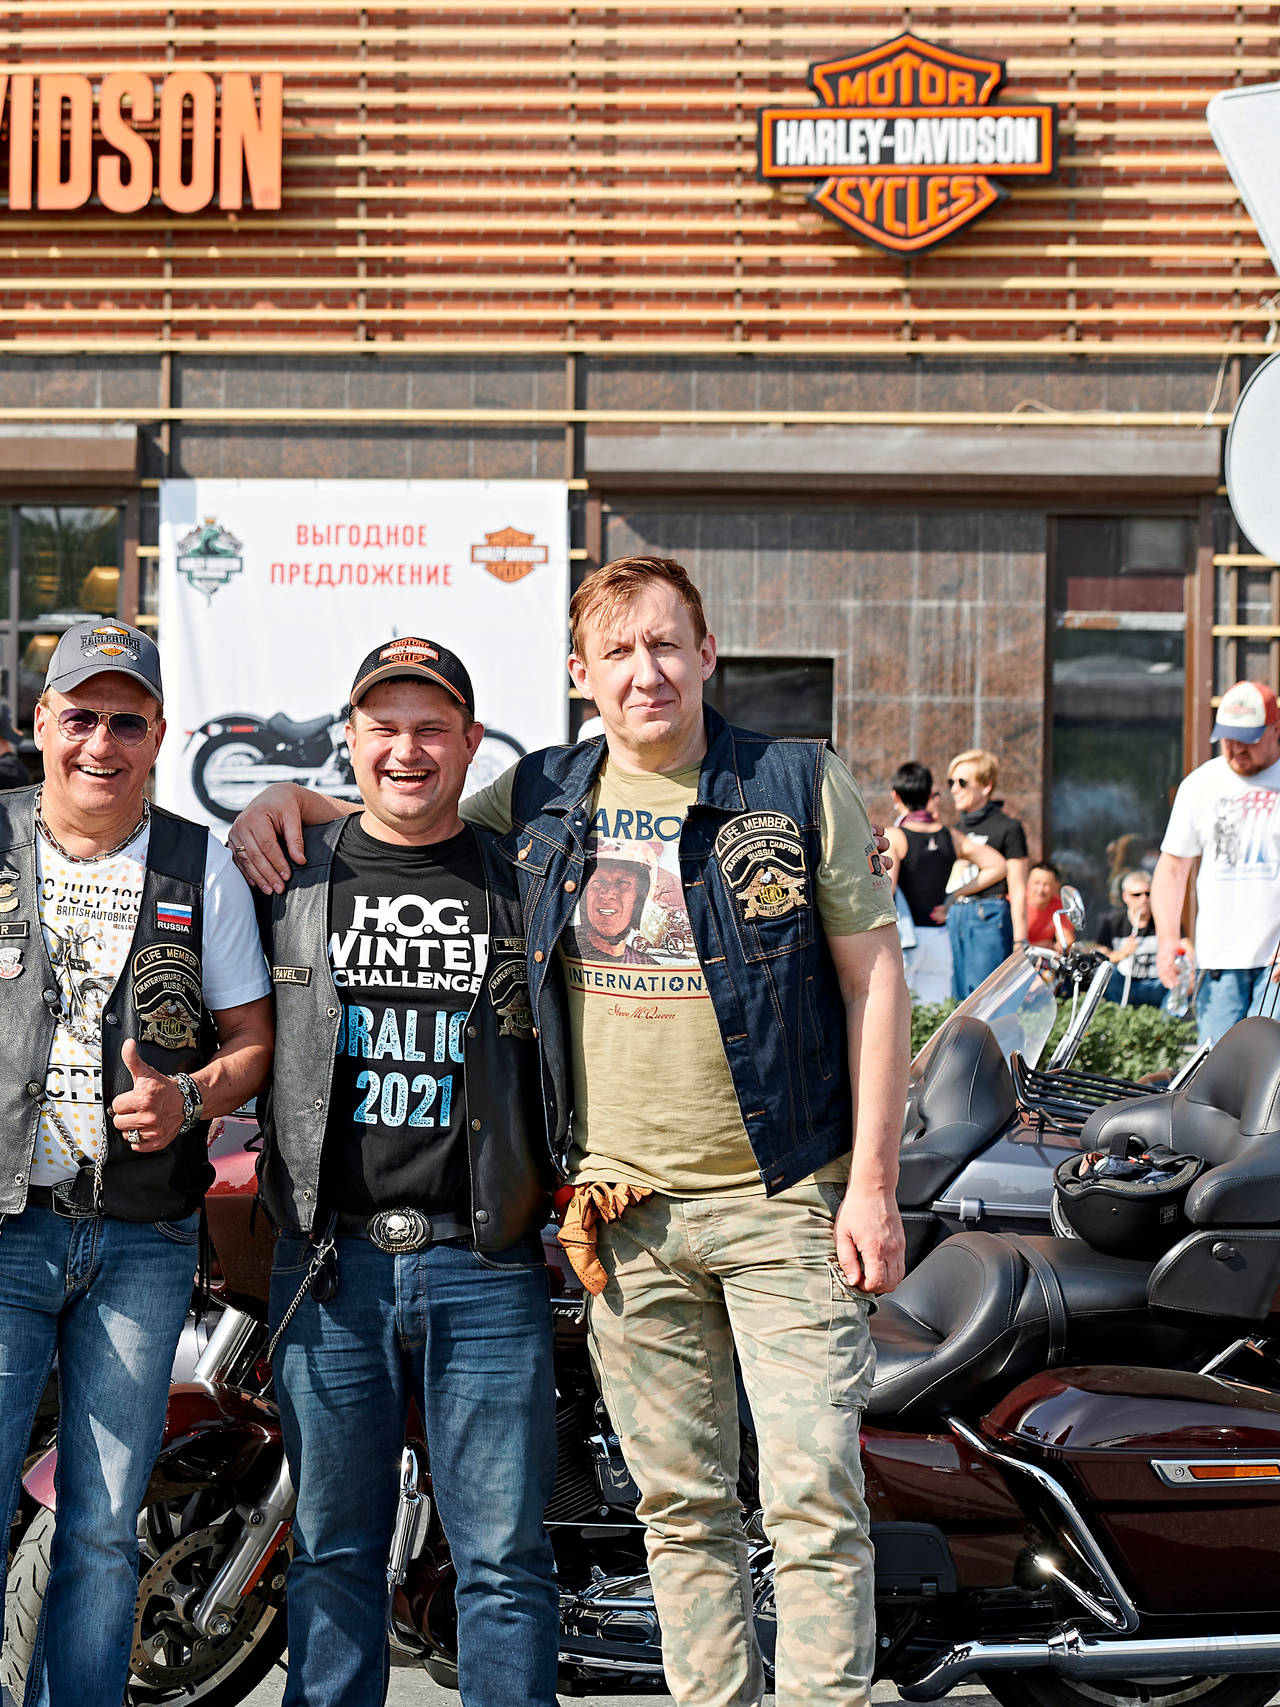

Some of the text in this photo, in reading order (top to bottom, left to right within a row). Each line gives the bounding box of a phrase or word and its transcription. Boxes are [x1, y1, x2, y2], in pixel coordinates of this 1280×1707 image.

[837, 52, 977, 106] MOTOR
[775, 115, 1038, 166] HARLEY-DAVIDSON
[835, 175, 977, 238] CYCLES
[296, 523, 428, 550] ВЫГОДНОЕ
[270, 562, 453, 589] ПРЕДЛОЖЕНИЕ
[719, 816, 788, 845] LIFE MEMBER
[725, 840, 801, 872] EKATERINBURG CHAPTER
[747, 848, 776, 862] RUSSIA
[56, 905, 90, 918] BRITISH
[157, 920, 190, 934] RUSSIA
[140, 948, 198, 969] LIFE MEMBER
[136, 973, 182, 995] EKATERINBURG
[162, 981, 187, 994] RUSSIA
[275, 969, 298, 980] PAVEL
[332, 968, 483, 995] CHALLENGE
[607, 1003, 676, 1020] Steve McQueen
[353, 1069, 454, 1128] 2021
